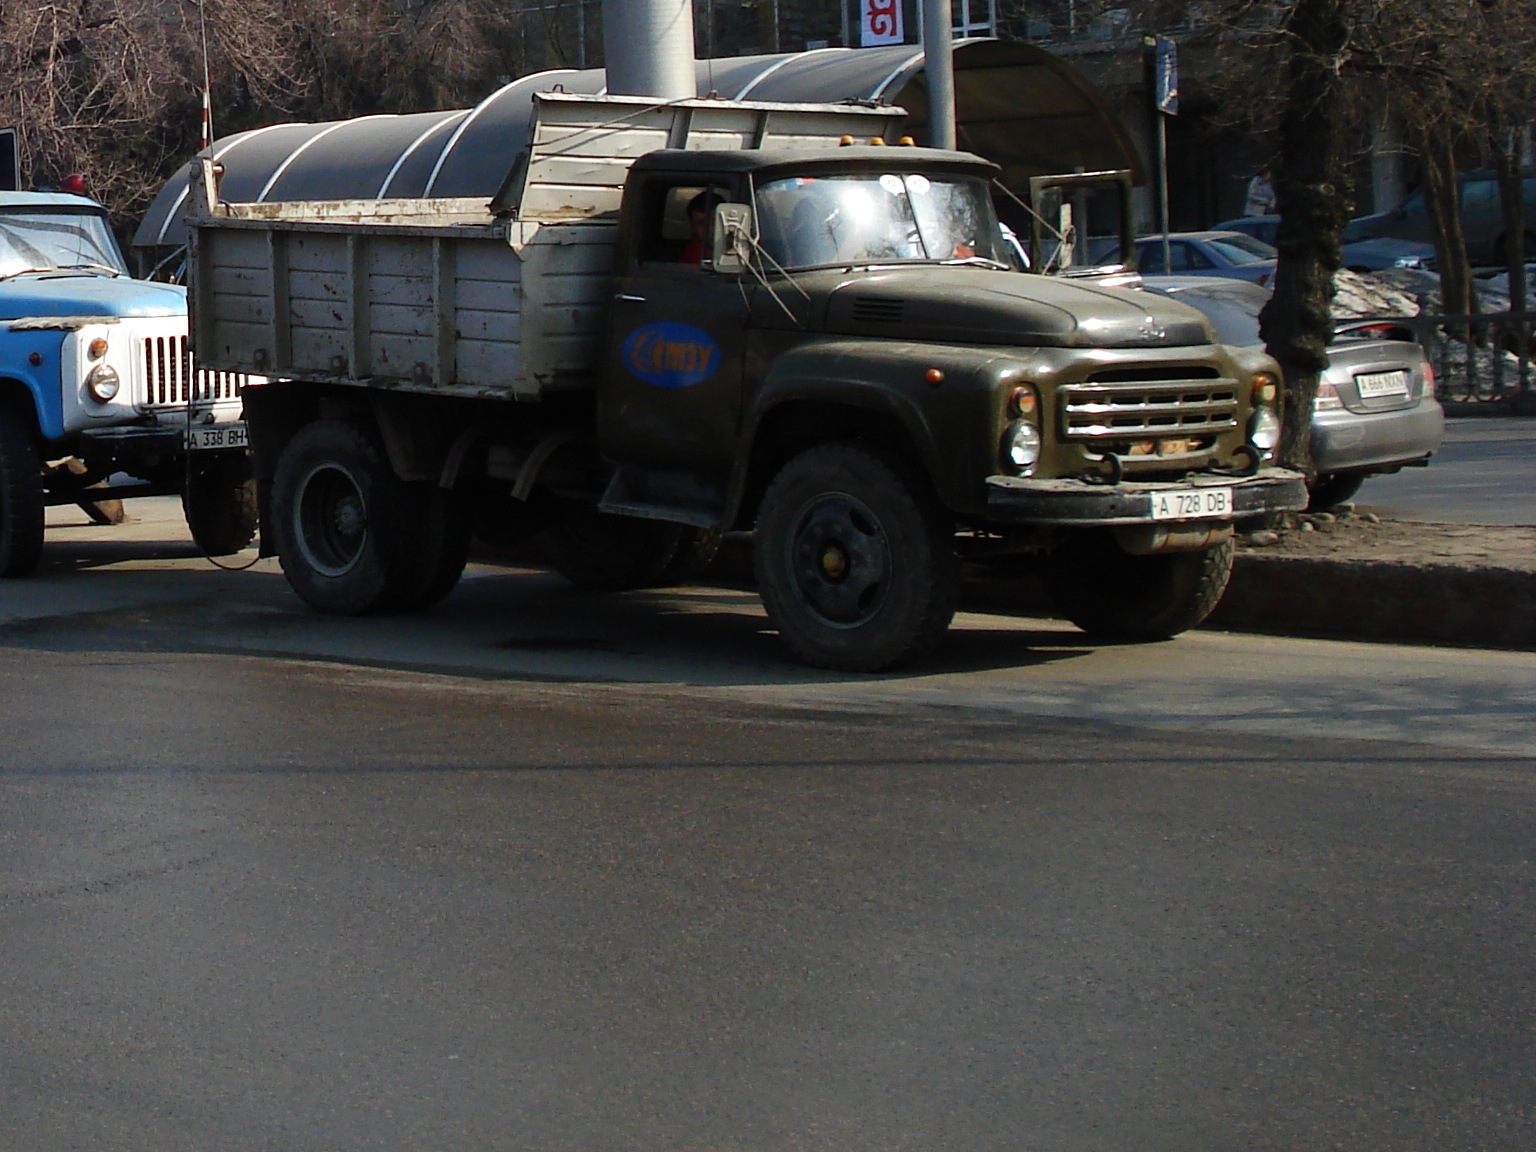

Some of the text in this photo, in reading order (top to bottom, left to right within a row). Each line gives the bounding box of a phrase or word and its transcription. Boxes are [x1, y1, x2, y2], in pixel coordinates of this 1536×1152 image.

[190, 433, 198, 446] A
[203, 431, 223, 446] 338
[1160, 492, 1225, 515] A 728 DB
